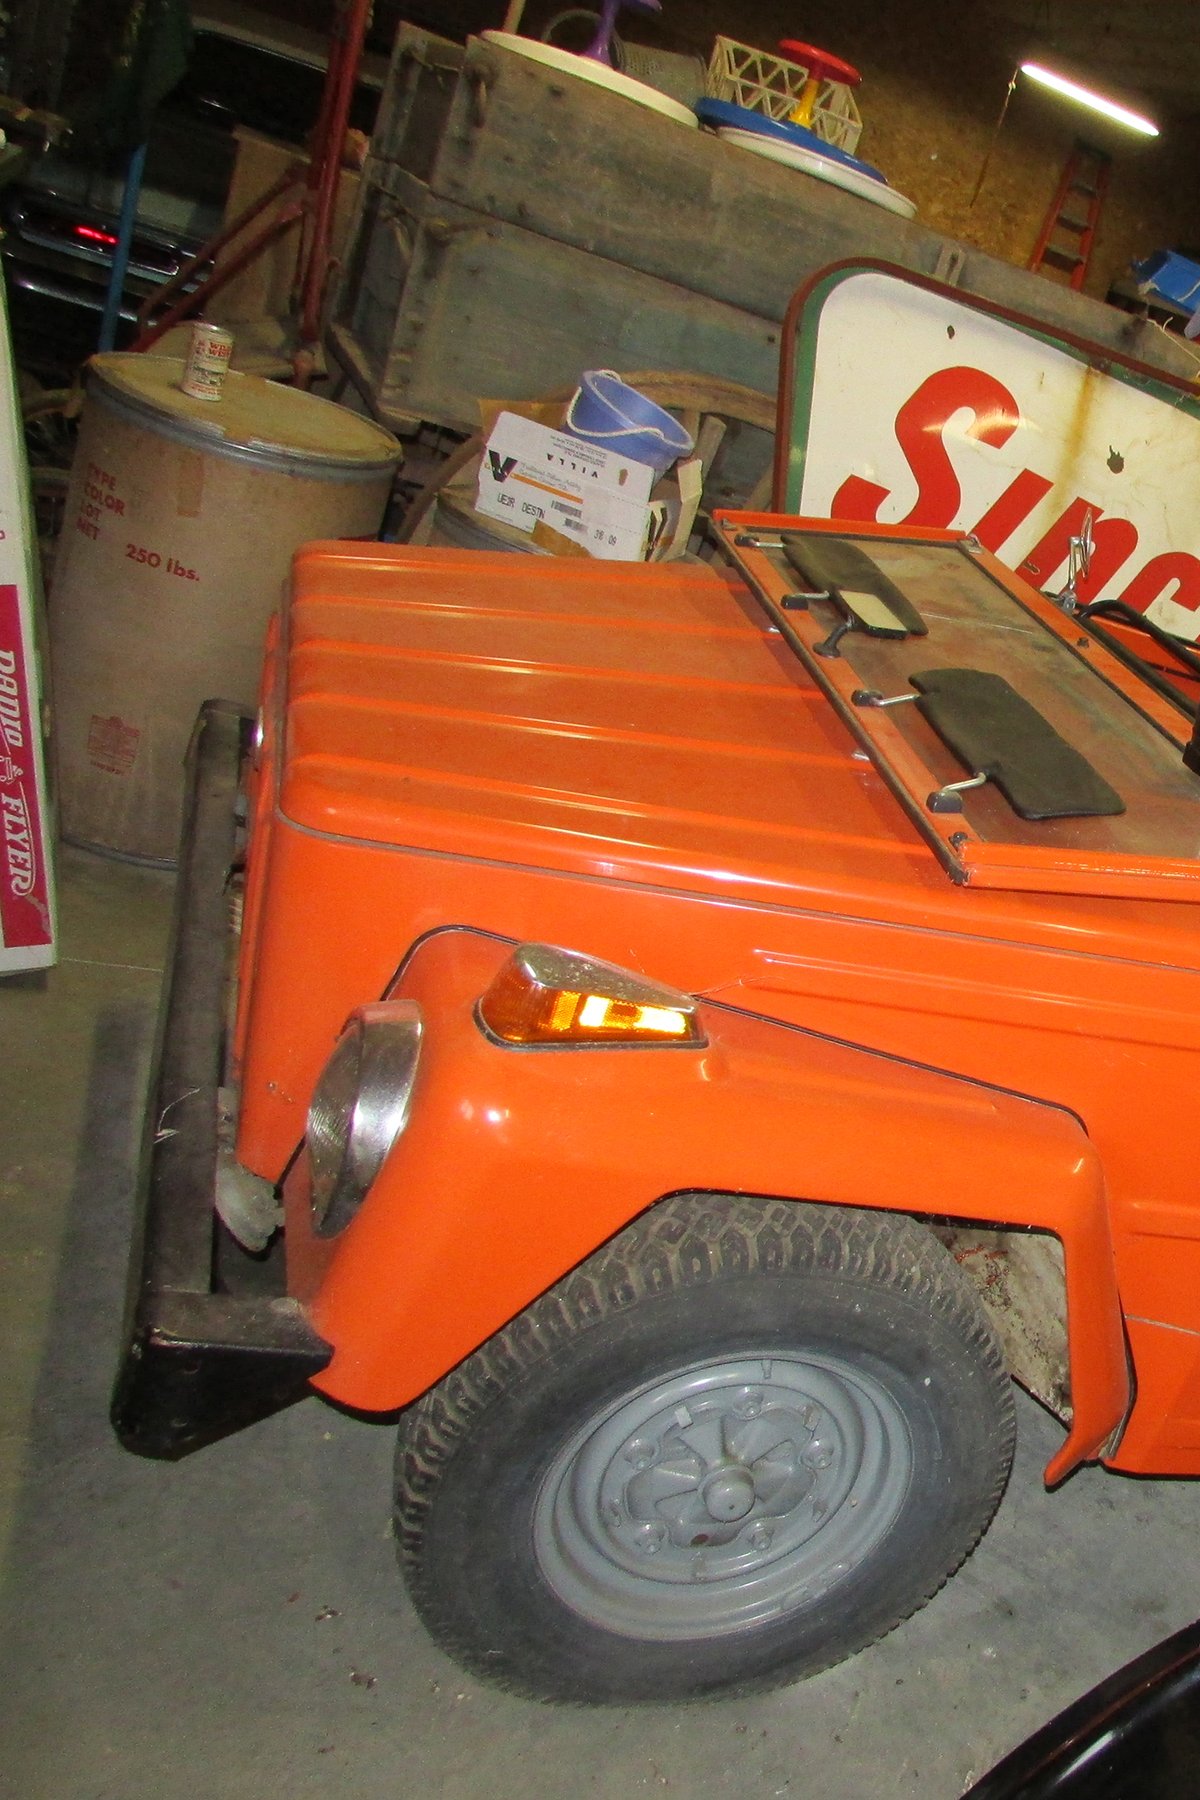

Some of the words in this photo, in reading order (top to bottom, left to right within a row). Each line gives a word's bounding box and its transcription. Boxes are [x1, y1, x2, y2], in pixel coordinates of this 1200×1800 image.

[546, 452, 598, 478] VILLA
[84, 481, 125, 516] COLOR
[126, 543, 161, 568] 250
[166, 558, 199, 581] lbs.
[2, 792, 35, 896] FLYER
